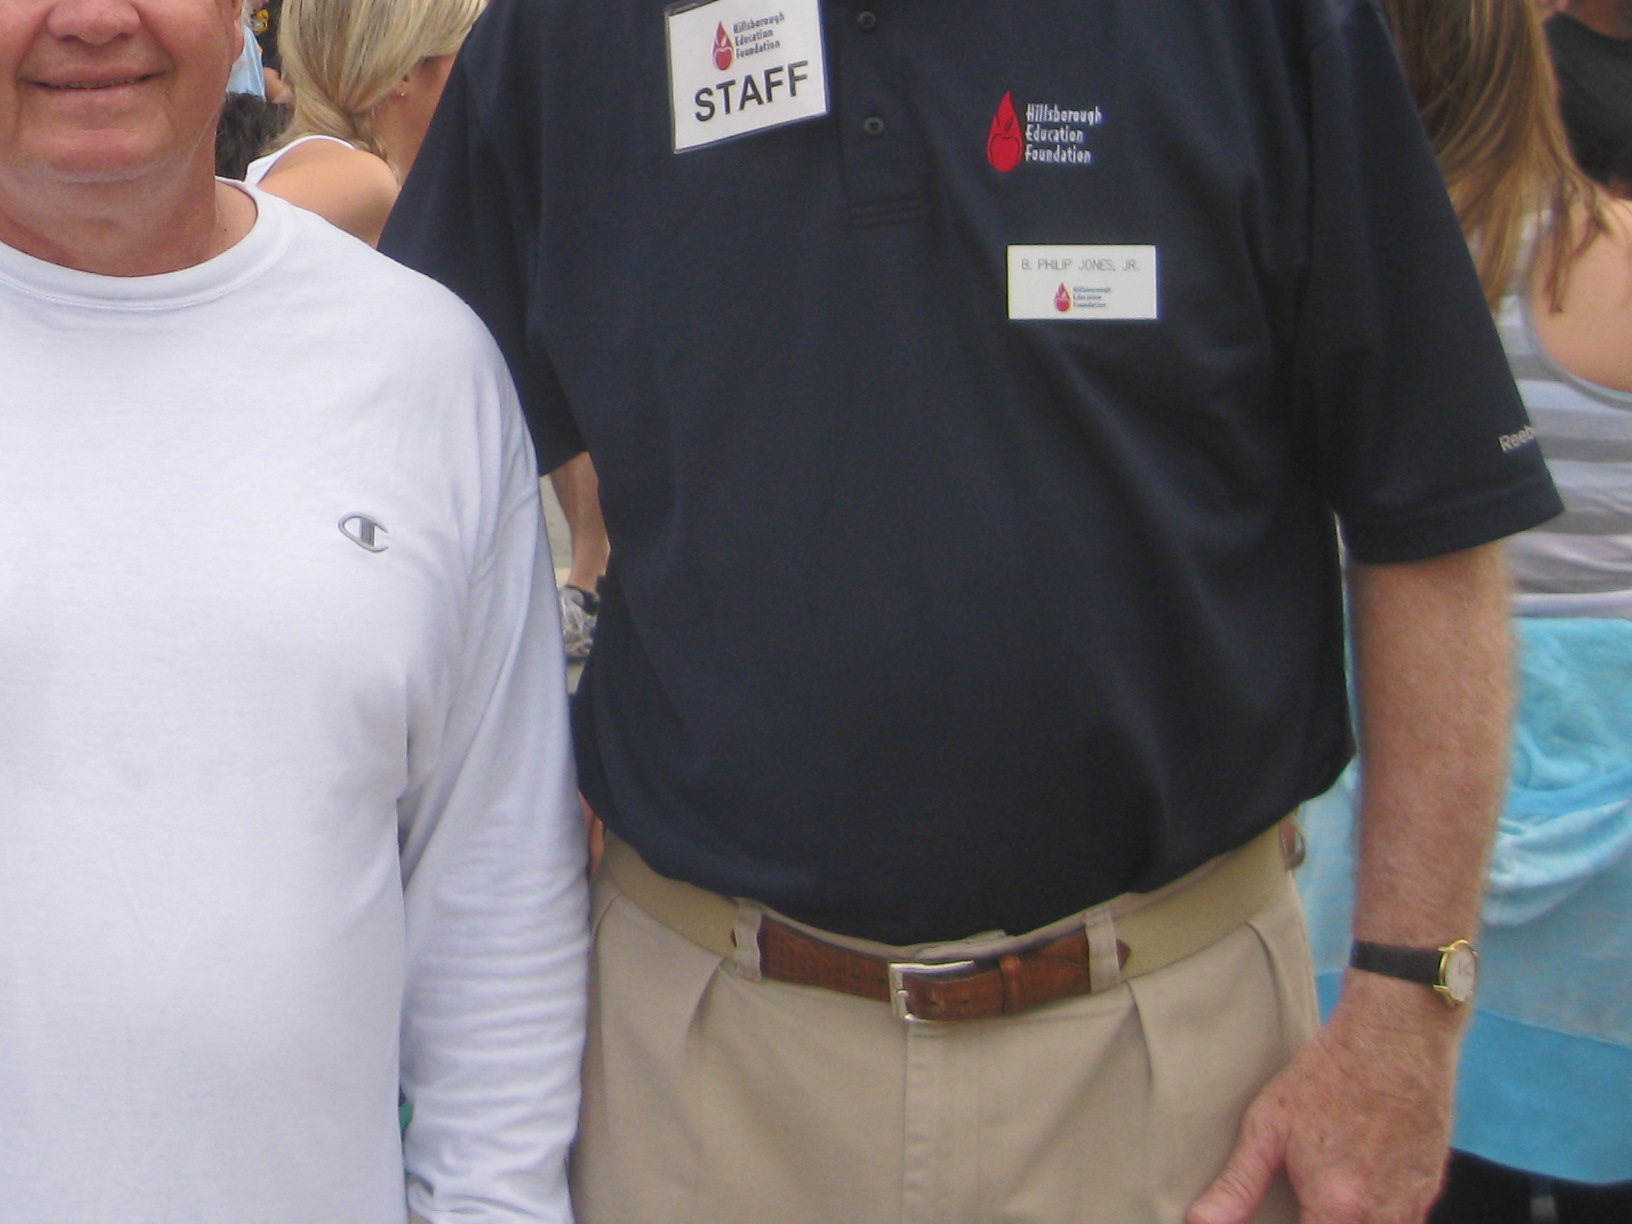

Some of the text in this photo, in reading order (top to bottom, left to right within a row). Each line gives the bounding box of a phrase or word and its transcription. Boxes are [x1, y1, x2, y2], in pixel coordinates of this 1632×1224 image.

[733, 11, 785, 34] Hillsborough
[734, 28, 774, 47] Education
[736, 39, 781, 59] Foundation
[693, 60, 809, 123] STAFF
[1026, 103, 1102, 126] Hillsborough
[1025, 123, 1084, 144] Education
[1025, 144, 1092, 164] Foundation
[1037, 258, 1072, 271] PHILIP
